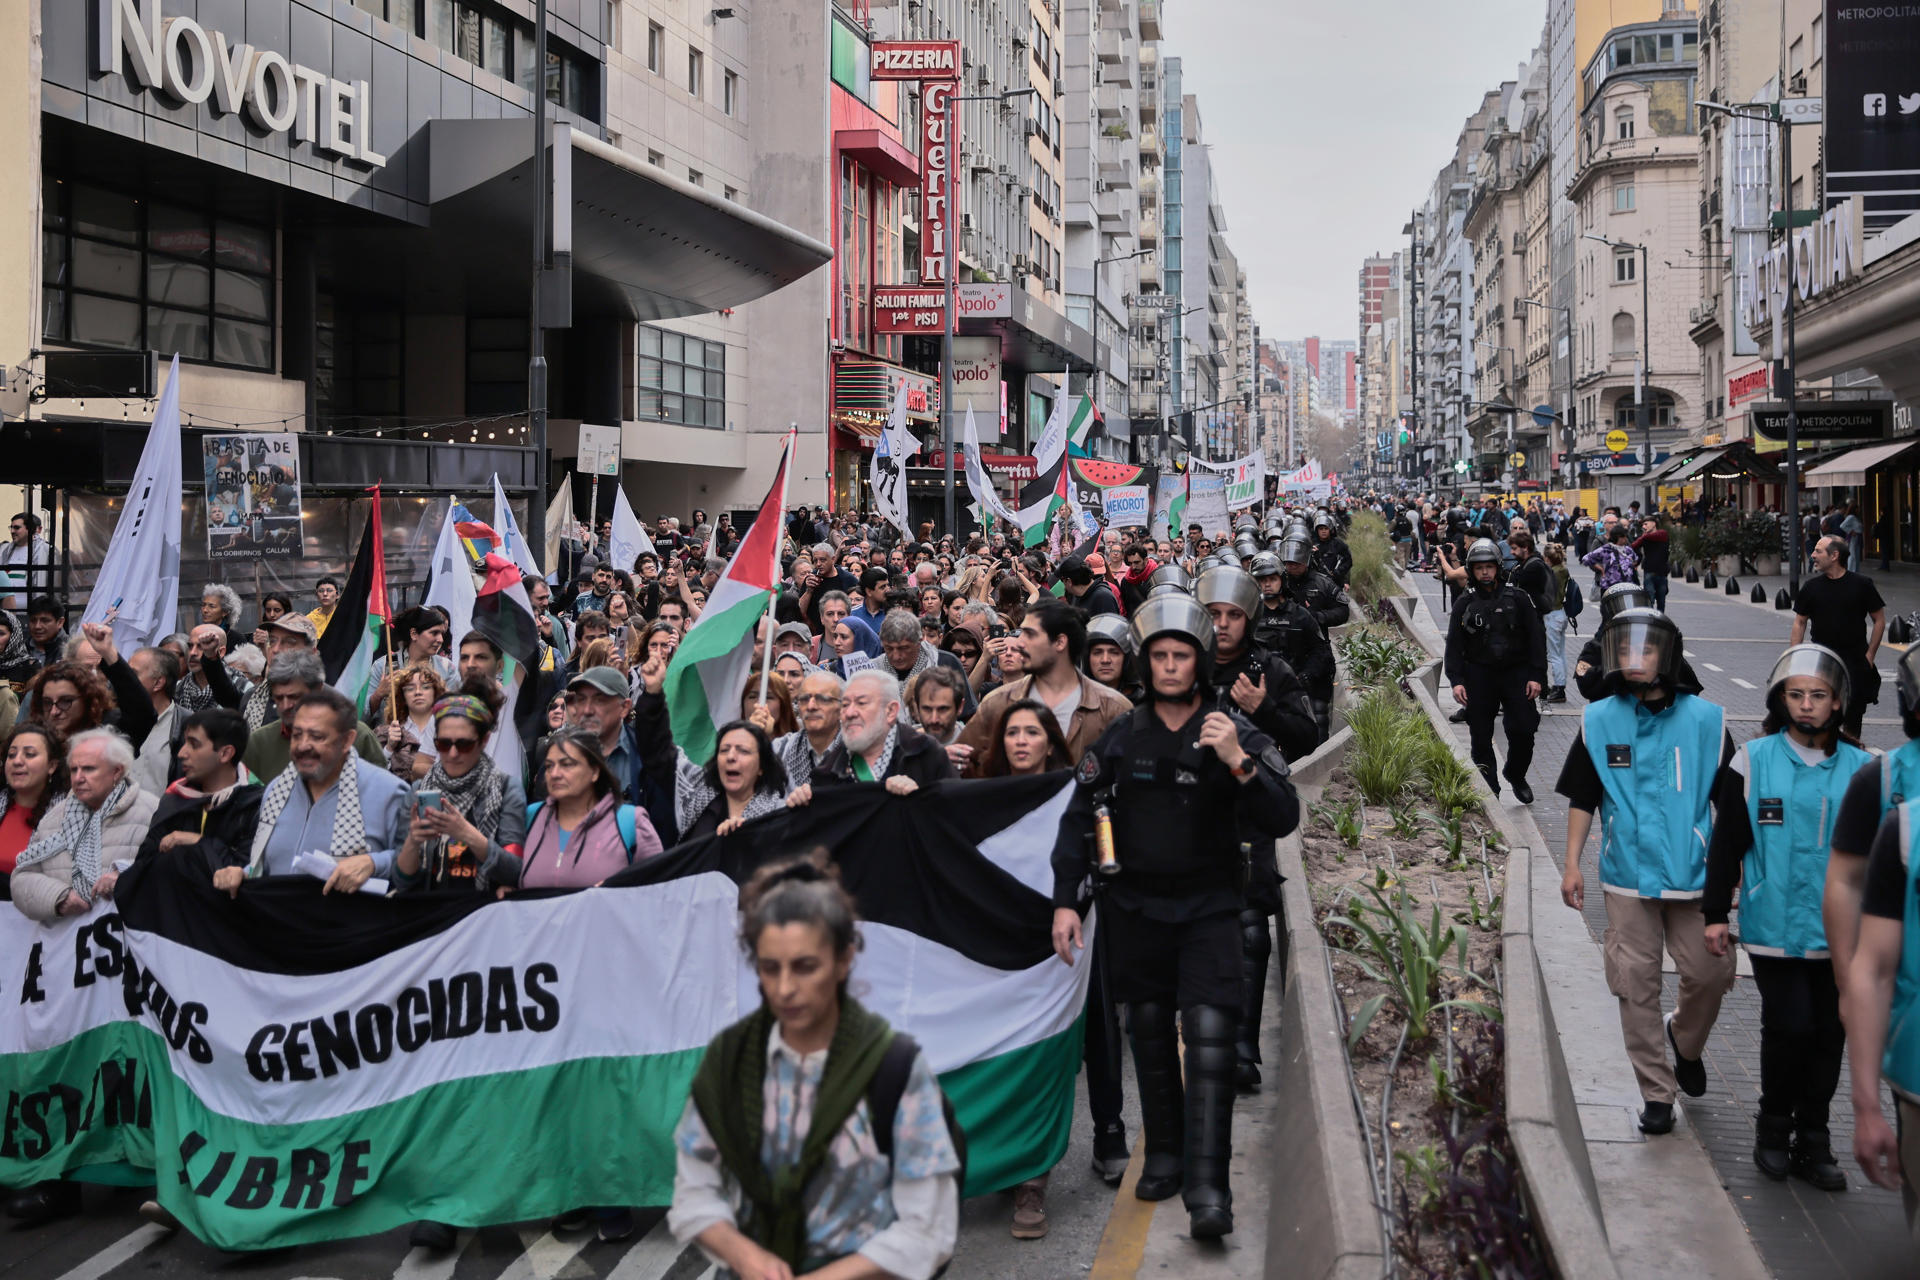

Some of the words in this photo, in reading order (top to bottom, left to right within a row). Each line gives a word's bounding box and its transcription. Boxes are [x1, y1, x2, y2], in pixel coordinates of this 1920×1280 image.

[873, 50, 954, 70] PIZZERIA
[98, 0, 386, 168] NOVOTEL
[875, 295, 906, 308] SALON
[908, 294, 945, 308] FAMILIA
[1136, 297, 1174, 307] CINE
[915, 312, 938, 326] PISO
[1802, 416, 1872, 427] METROPOLITAN
[273, 441, 290, 453] DE
[1586, 457, 1614, 468] BBVA
[1106, 498, 1145, 513] MEKOROT
[245, 962, 560, 1083] GENOCIDAS
[178, 1130, 371, 1211] LIBRE
